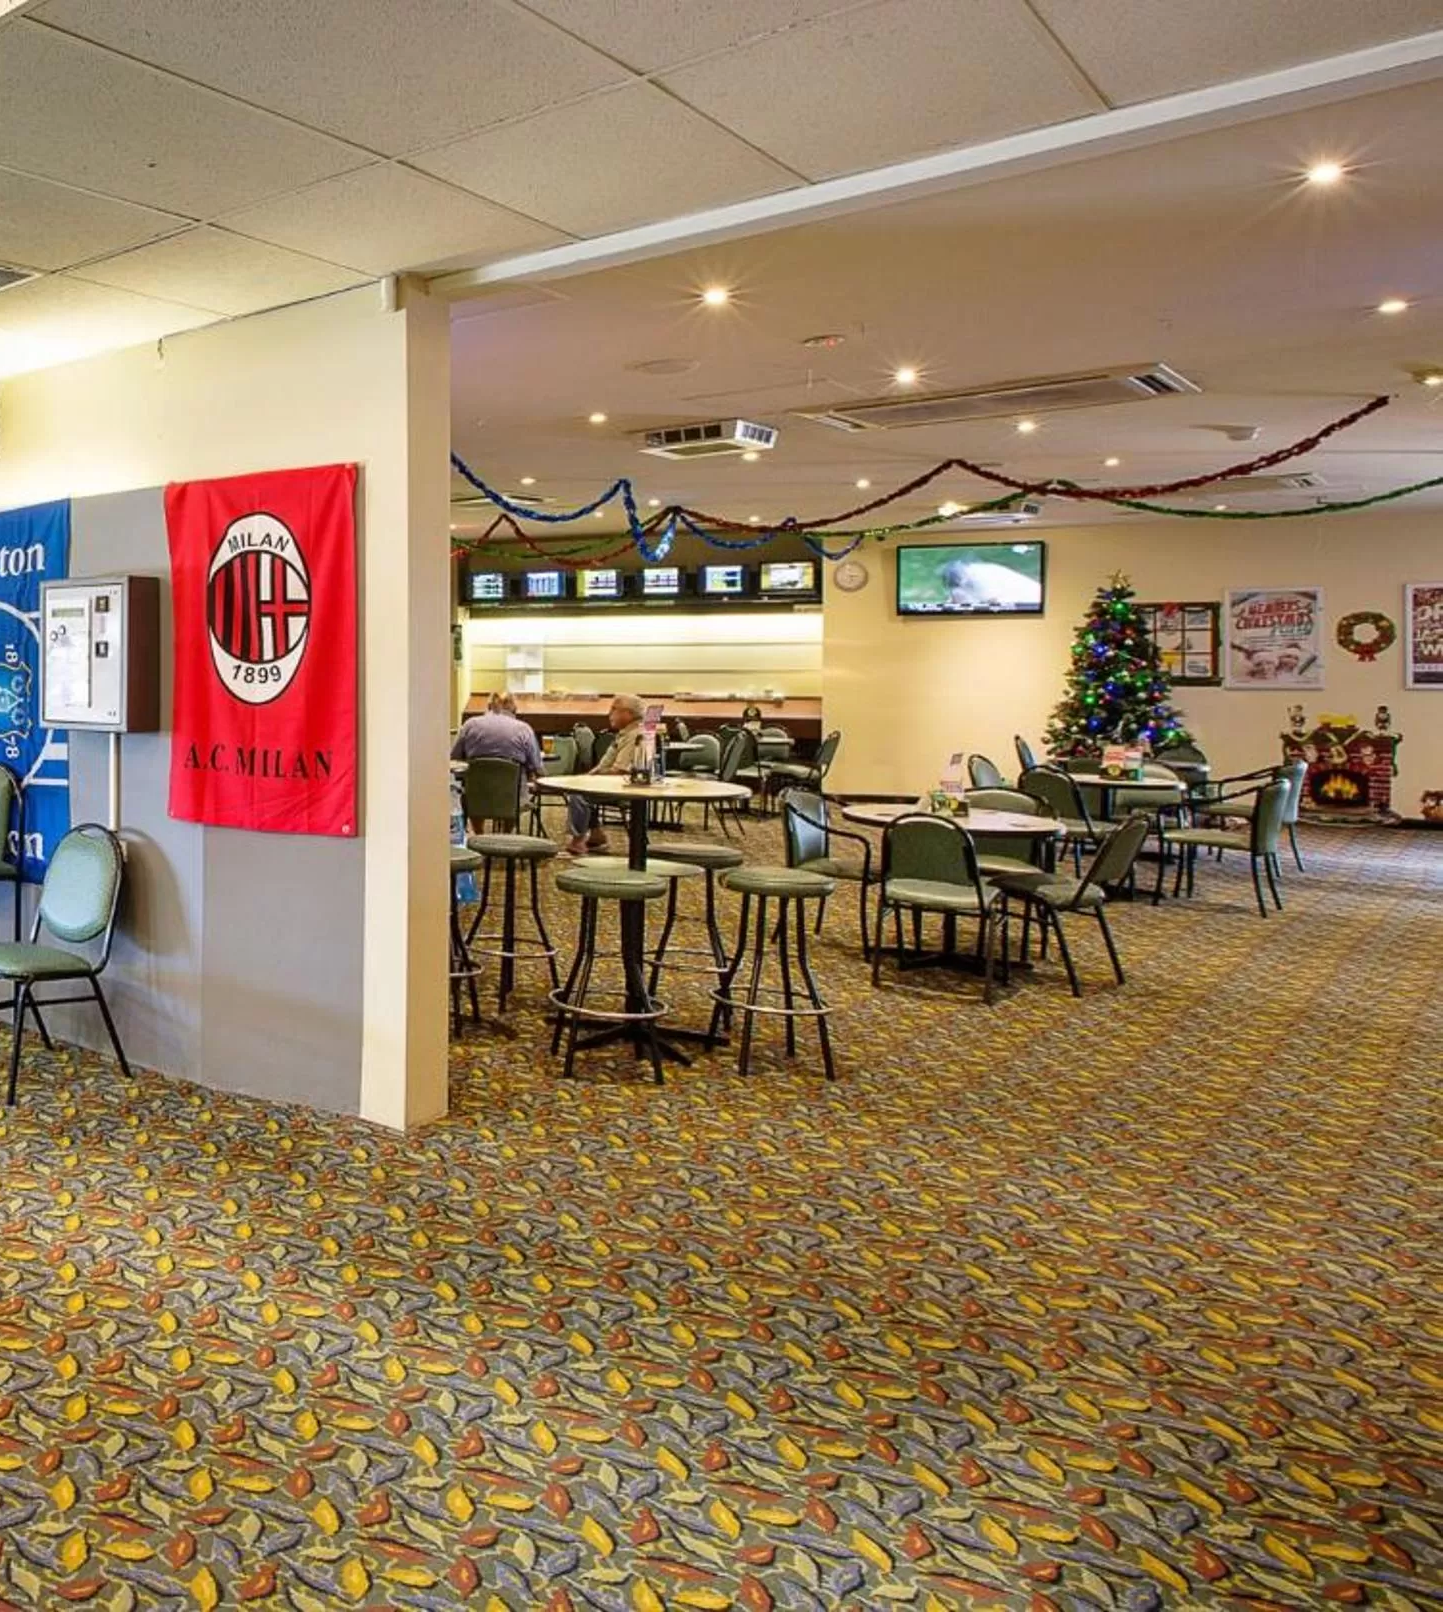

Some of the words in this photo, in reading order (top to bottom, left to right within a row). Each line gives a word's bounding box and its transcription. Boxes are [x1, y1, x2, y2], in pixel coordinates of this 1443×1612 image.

[227, 532, 290, 553] MILAN
[4, 643, 19, 663] 18
[232, 664, 282, 684] 1899
[2, 735, 21, 760] 78
[184, 741, 230, 772] A.C.
[235, 746, 333, 778] MILAN
